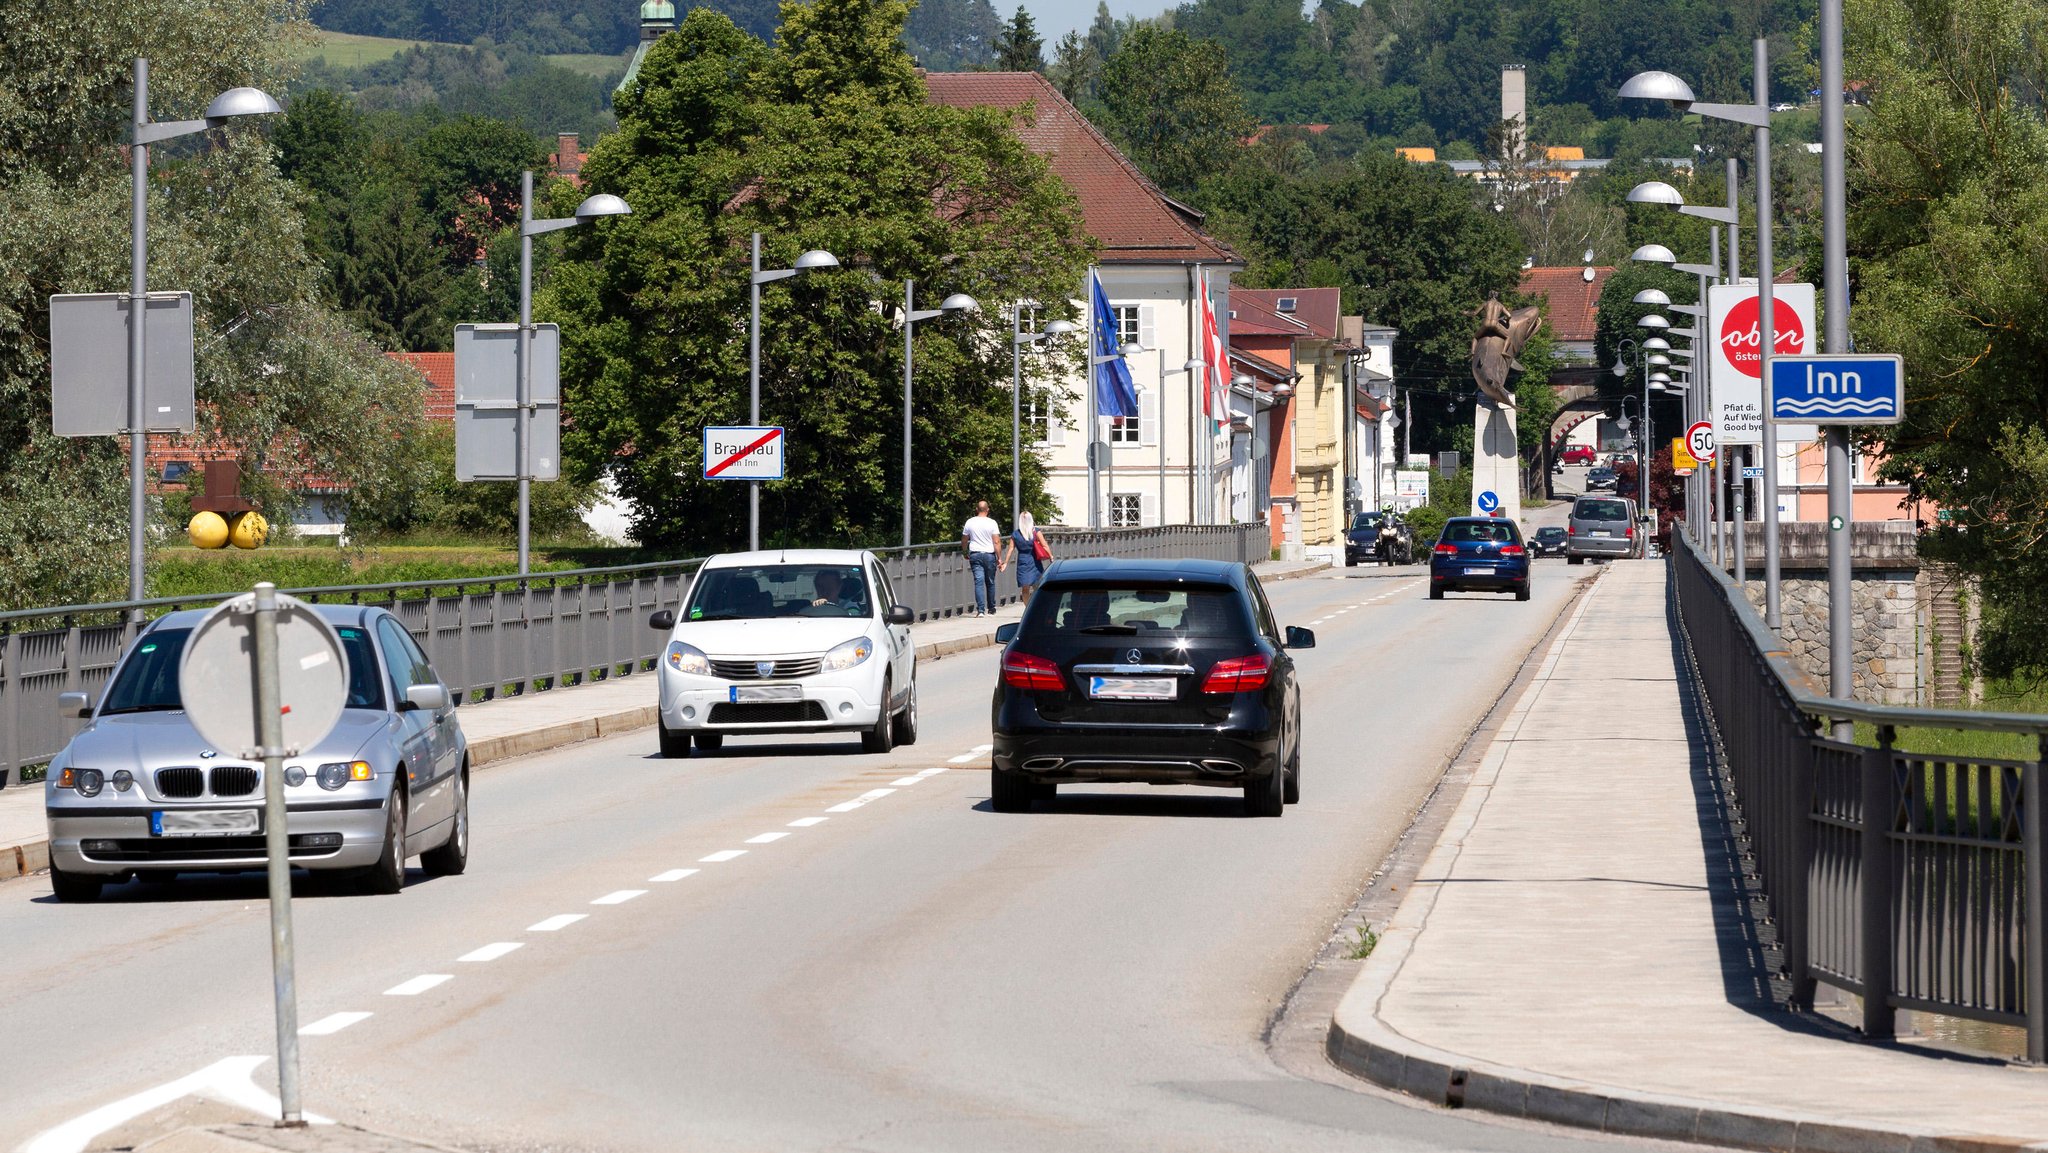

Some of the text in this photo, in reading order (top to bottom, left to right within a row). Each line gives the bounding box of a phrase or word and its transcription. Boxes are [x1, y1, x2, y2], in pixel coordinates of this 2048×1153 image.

[1806, 364, 1862, 394] Inn
[1723, 403, 1757, 412] Pfiat di.
[1723, 413, 1762, 422] Auf Wied
[1723, 423, 1747, 431] Good
[1694, 432, 1714, 451] 50
[714, 442, 773, 455] Braunau
[745, 459, 758, 467] Inn
